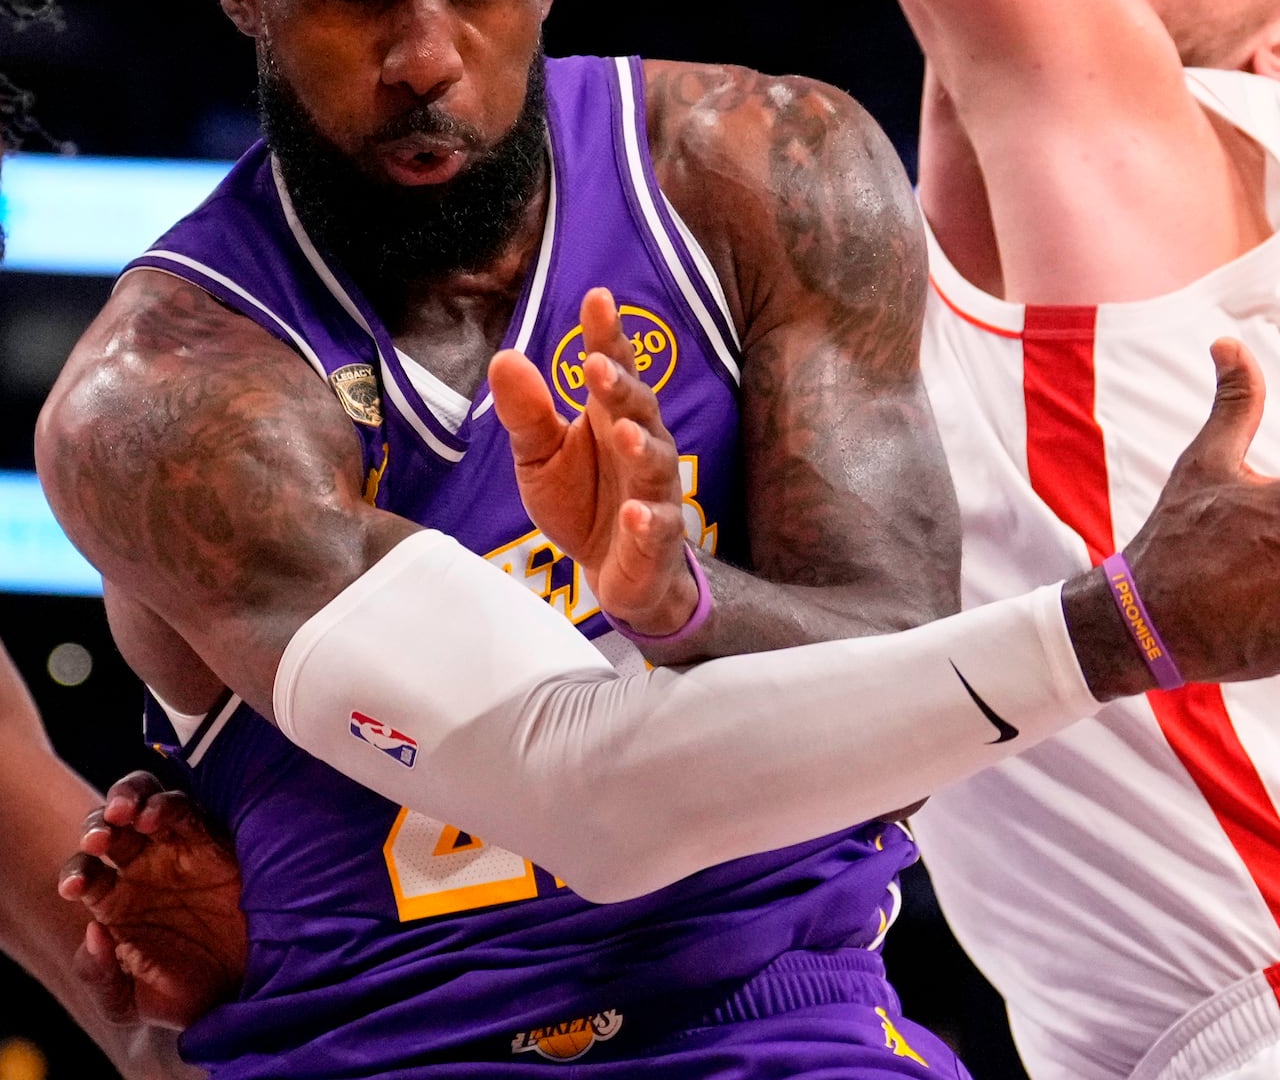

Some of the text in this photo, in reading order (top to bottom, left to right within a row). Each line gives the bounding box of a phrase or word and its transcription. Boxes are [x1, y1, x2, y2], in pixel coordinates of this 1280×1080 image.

[335, 368, 373, 382] LEGACY
[1111, 572, 1162, 661] I PROMISE
